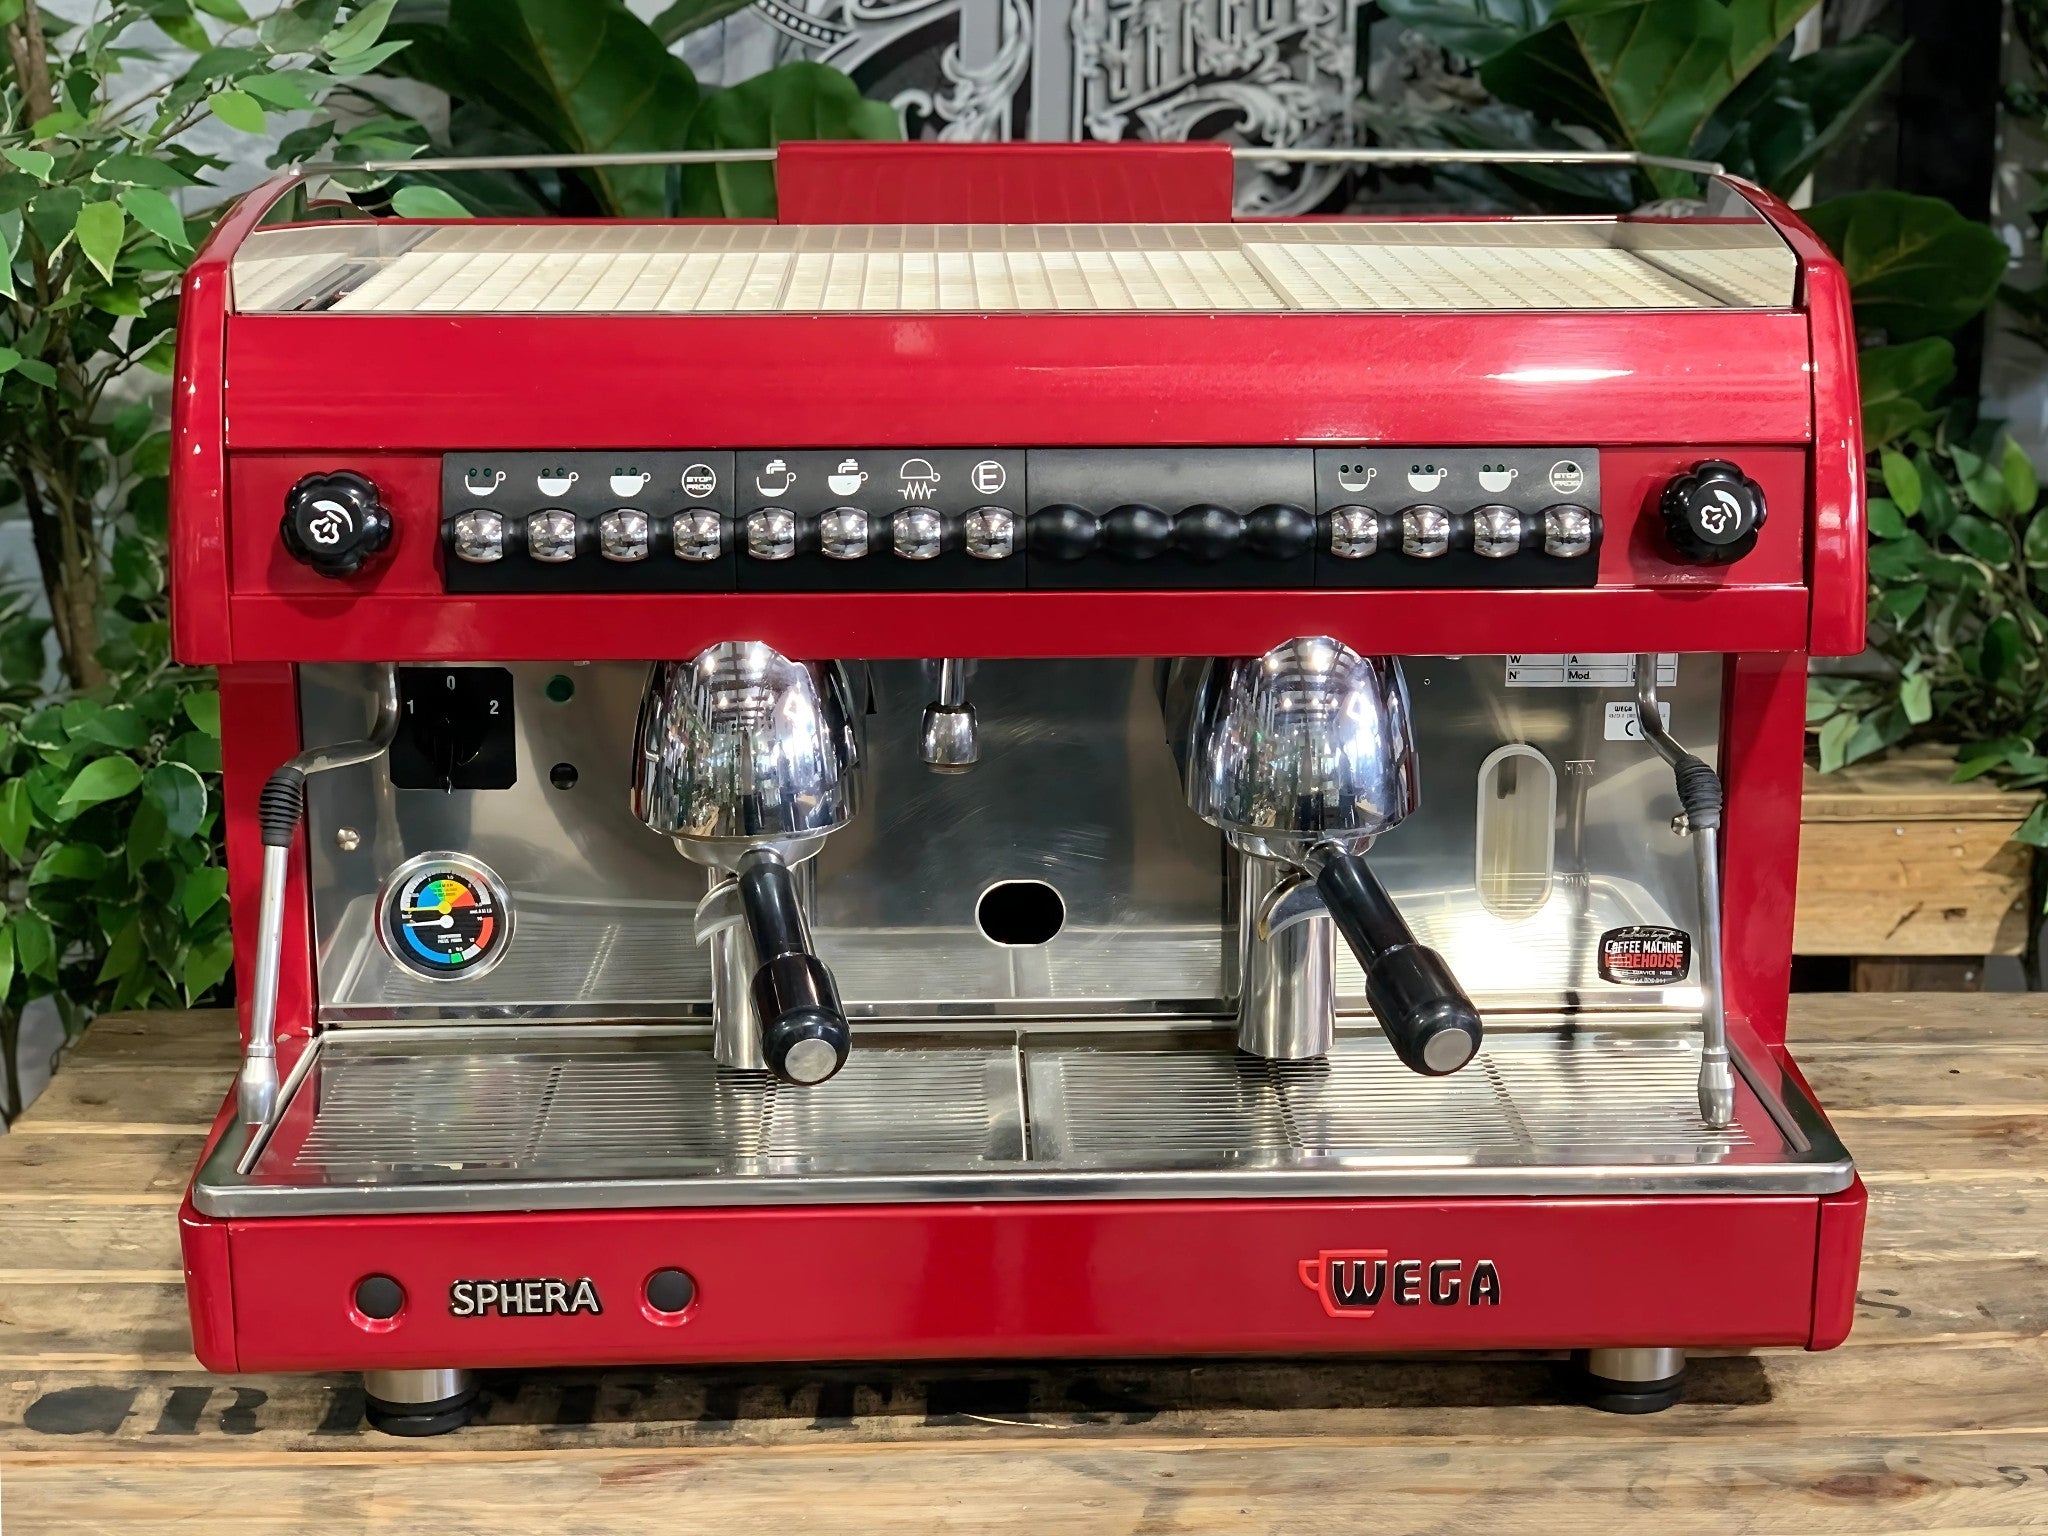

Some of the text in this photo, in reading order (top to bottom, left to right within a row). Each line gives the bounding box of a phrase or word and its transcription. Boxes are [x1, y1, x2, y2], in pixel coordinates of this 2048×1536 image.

[979, 464, 999, 490] E
[1510, 655, 1522, 664] W
[1570, 655, 1578, 664] A
[406, 700, 415, 714] 1
[488, 700, 499, 715] 2
[1564, 763, 1594, 776] MAX
[1564, 875, 1588, 888] MIN
[1643, 940, 1684, 953] MACHINE
[1332, 1260, 1501, 1306] WEGA
[451, 1279, 602, 1316] SPHERA
